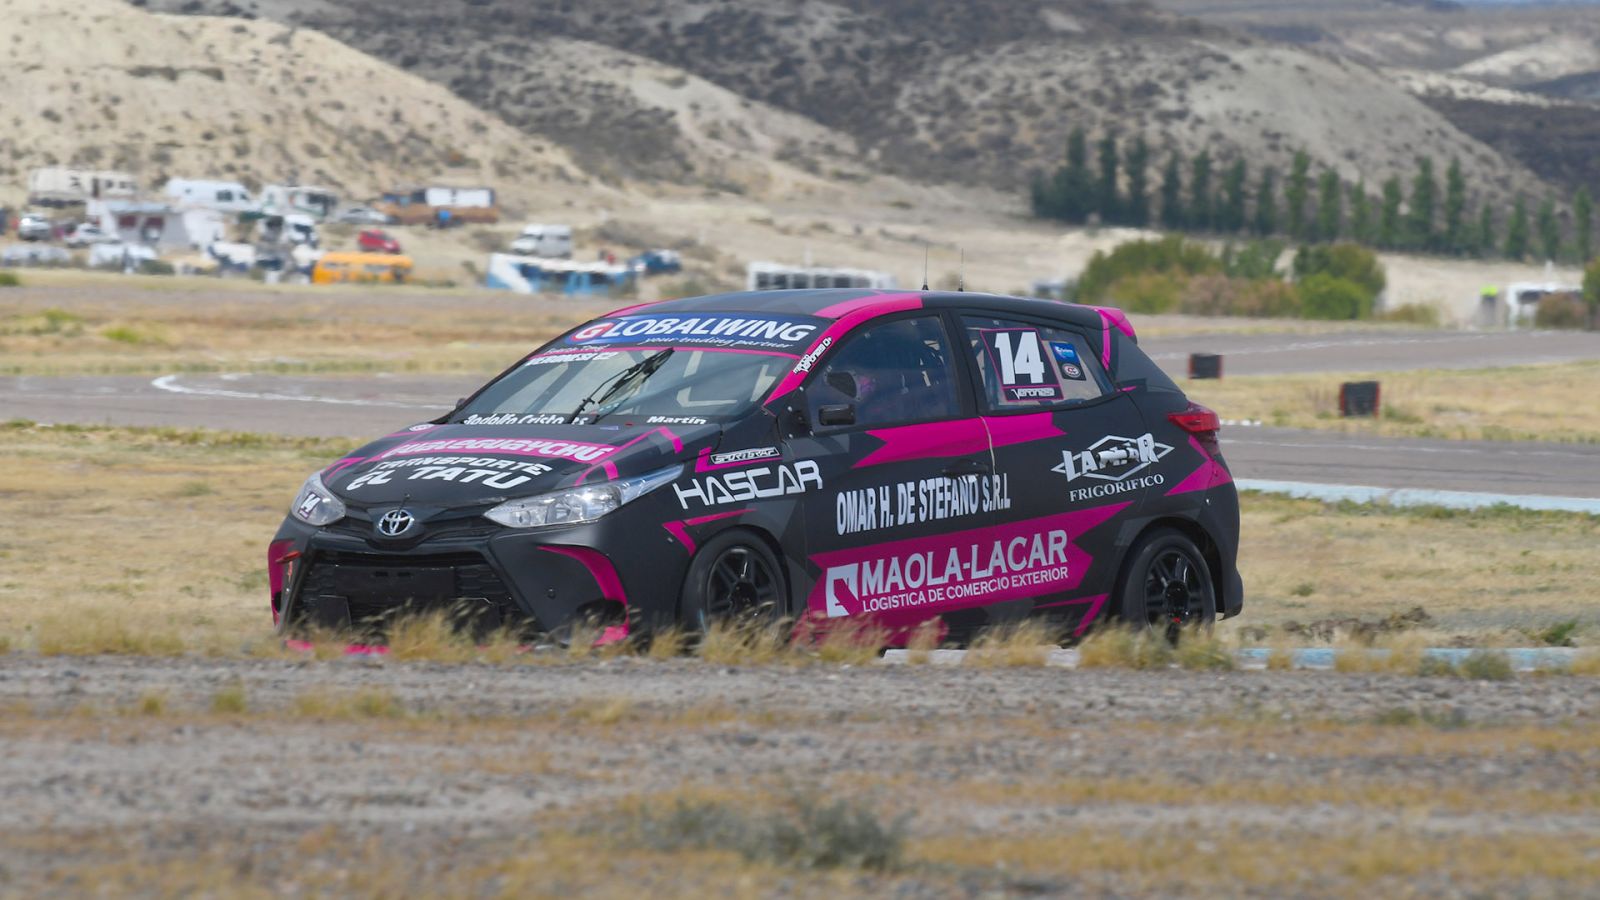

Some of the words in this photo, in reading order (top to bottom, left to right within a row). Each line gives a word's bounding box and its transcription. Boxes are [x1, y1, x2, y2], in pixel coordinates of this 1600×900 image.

[575, 318, 817, 342] GLOBALWING
[637, 336, 681, 346] your
[680, 335, 733, 347] trading
[731, 339, 795, 349] partner
[994, 331, 1045, 385] 14
[647, 415, 707, 425] Martin
[346, 469, 396, 491] EL
[408, 466, 532, 490] TATU
[368, 456, 553, 476] TRANSPORTE
[672, 460, 823, 510] HASCAR
[1068, 473, 1165, 502] FRIGORIFICO
[836, 487, 877, 536] OMAR
[879, 485, 894, 528] H.
[897, 480, 916, 526] DE
[918, 473, 979, 523] STEFANO
[861, 529, 1068, 597] MAOLA-LACAR
[862, 591, 927, 613] LOGISTICA
[928, 587, 945, 603] DE
[946, 576, 1010, 599] COMERCIO
[1011, 566, 1069, 588] EXTERIOR
